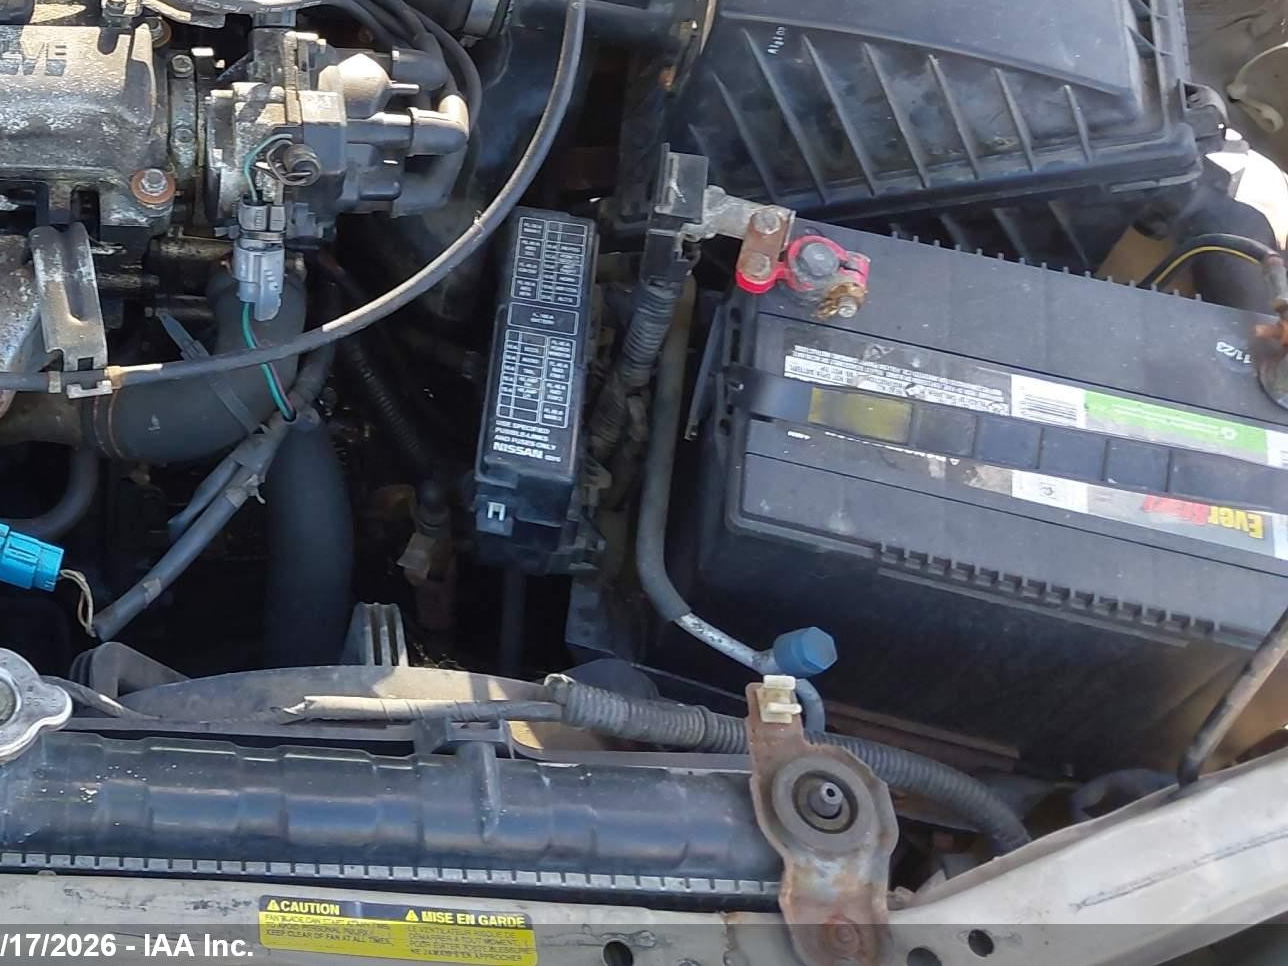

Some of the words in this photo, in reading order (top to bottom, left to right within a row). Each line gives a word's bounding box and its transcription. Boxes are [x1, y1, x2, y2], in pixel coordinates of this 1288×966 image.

[493, 442, 543, 459] NISSAN
[280, 900, 340, 916] CAUTION
[421, 910, 455, 923] MISE
[456, 913, 476, 925] EN
[478, 914, 526, 928] GARDE
